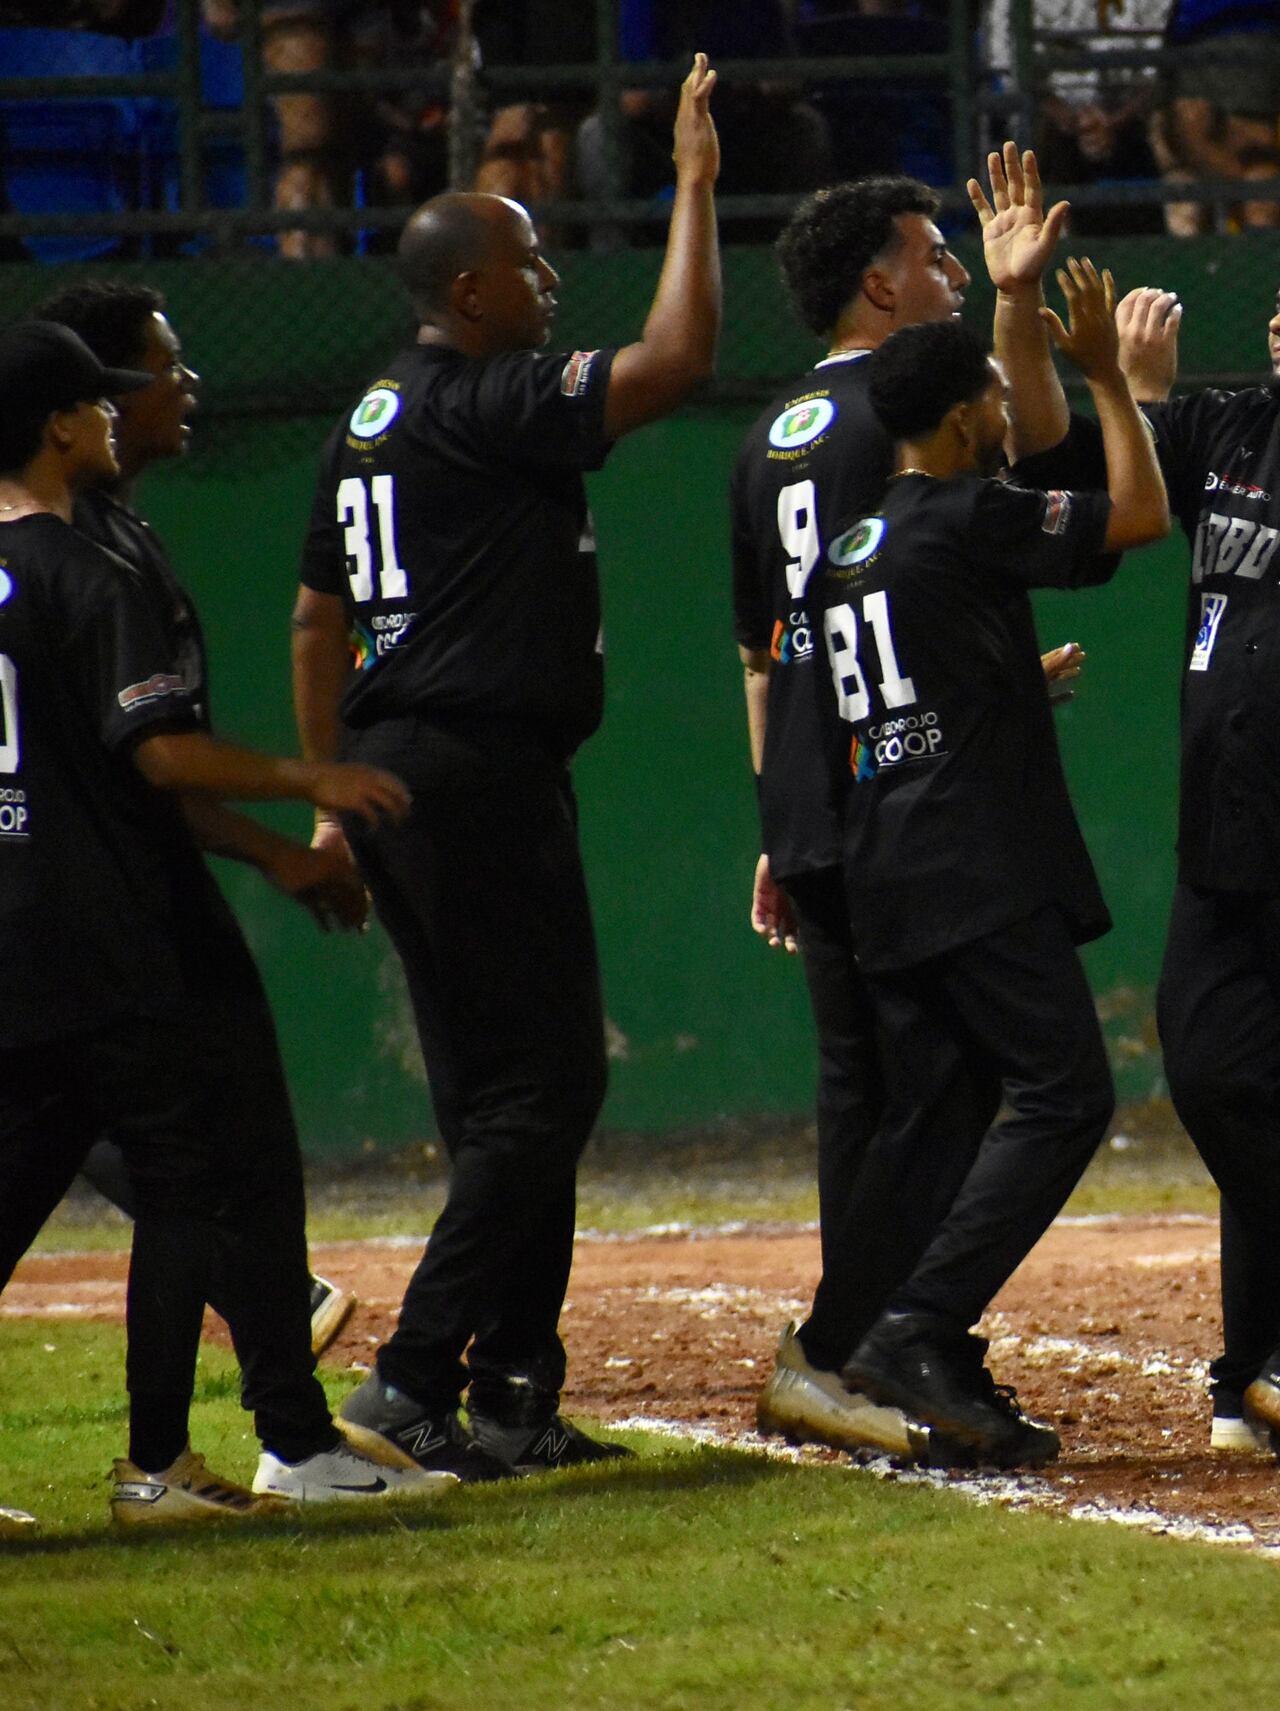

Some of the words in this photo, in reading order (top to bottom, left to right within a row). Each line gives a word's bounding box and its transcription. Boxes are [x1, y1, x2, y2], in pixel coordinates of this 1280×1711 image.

[336, 474, 408, 602] 31
[777, 479, 820, 599] 9
[823, 590, 918, 723] 81
[874, 728, 943, 763] COOP
